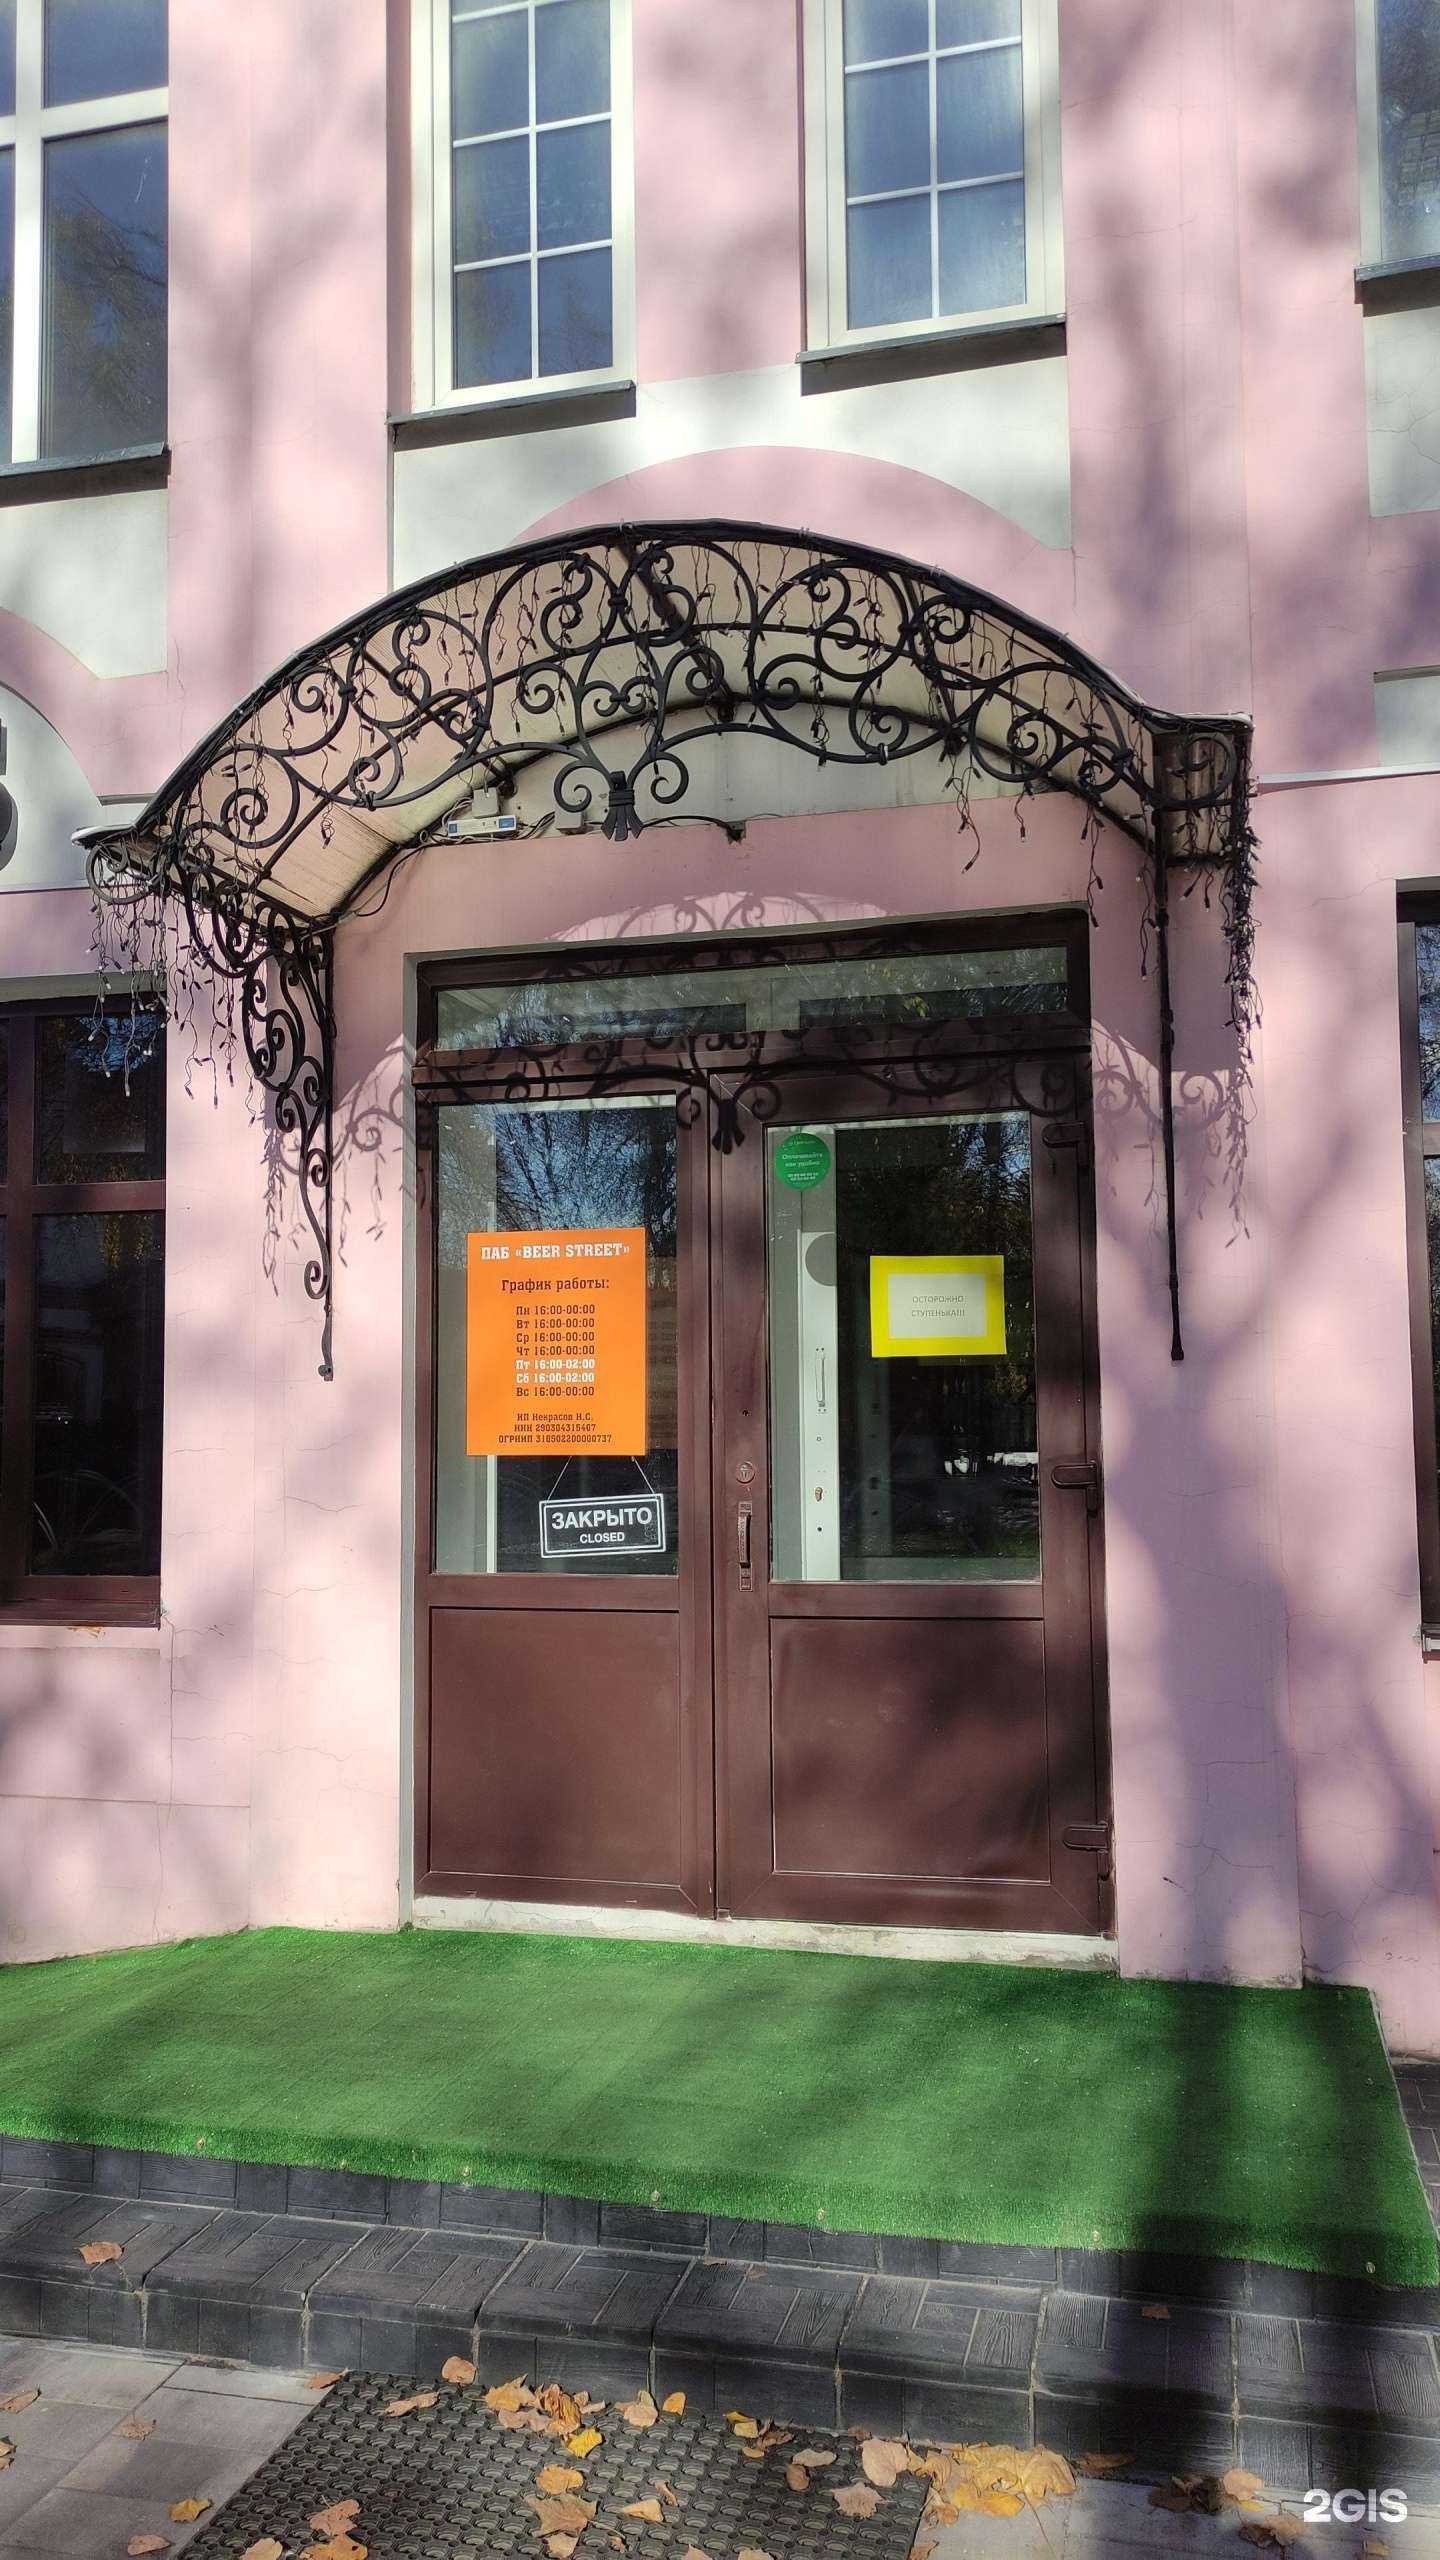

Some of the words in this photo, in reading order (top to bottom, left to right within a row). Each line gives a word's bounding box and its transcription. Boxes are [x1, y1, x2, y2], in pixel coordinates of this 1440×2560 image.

[481, 1246, 510, 1260] ПАБ
[515, 1245, 561, 1259] «BEER
[565, 1243, 630, 1257] STREET»
[501, 1278, 551, 1293] График
[556, 1276, 610, 1292] работы:
[912, 1295, 964, 1304] ОСТОРОЖНО
[516, 1306, 530, 1315] Пн
[534, 1304, 595, 1315] 16:00-00:00
[516, 1319, 530, 1329] Вт
[534, 1318, 595, 1329] 16:00-00:00
[516, 1333, 530, 1344] Ср
[534, 1332, 595, 1342] 16:00-00:00
[516, 1346, 530, 1356] Чт
[534, 1345, 595, 1356] 16:00-00:00
[515, 1359, 530, 1369] Пт
[534, 1359, 595, 1369] 16:00-02:00
[516, 1373, 529, 1383] Сб
[534, 1373, 595, 1383] 16:00-02:00
[516, 1387, 529, 1397] Вс
[534, 1386, 595, 1396] 16:00-00:00
[552, 1507, 652, 1530] ЗАКРЫТО
[579, 1532, 625, 1544] CLOSED
